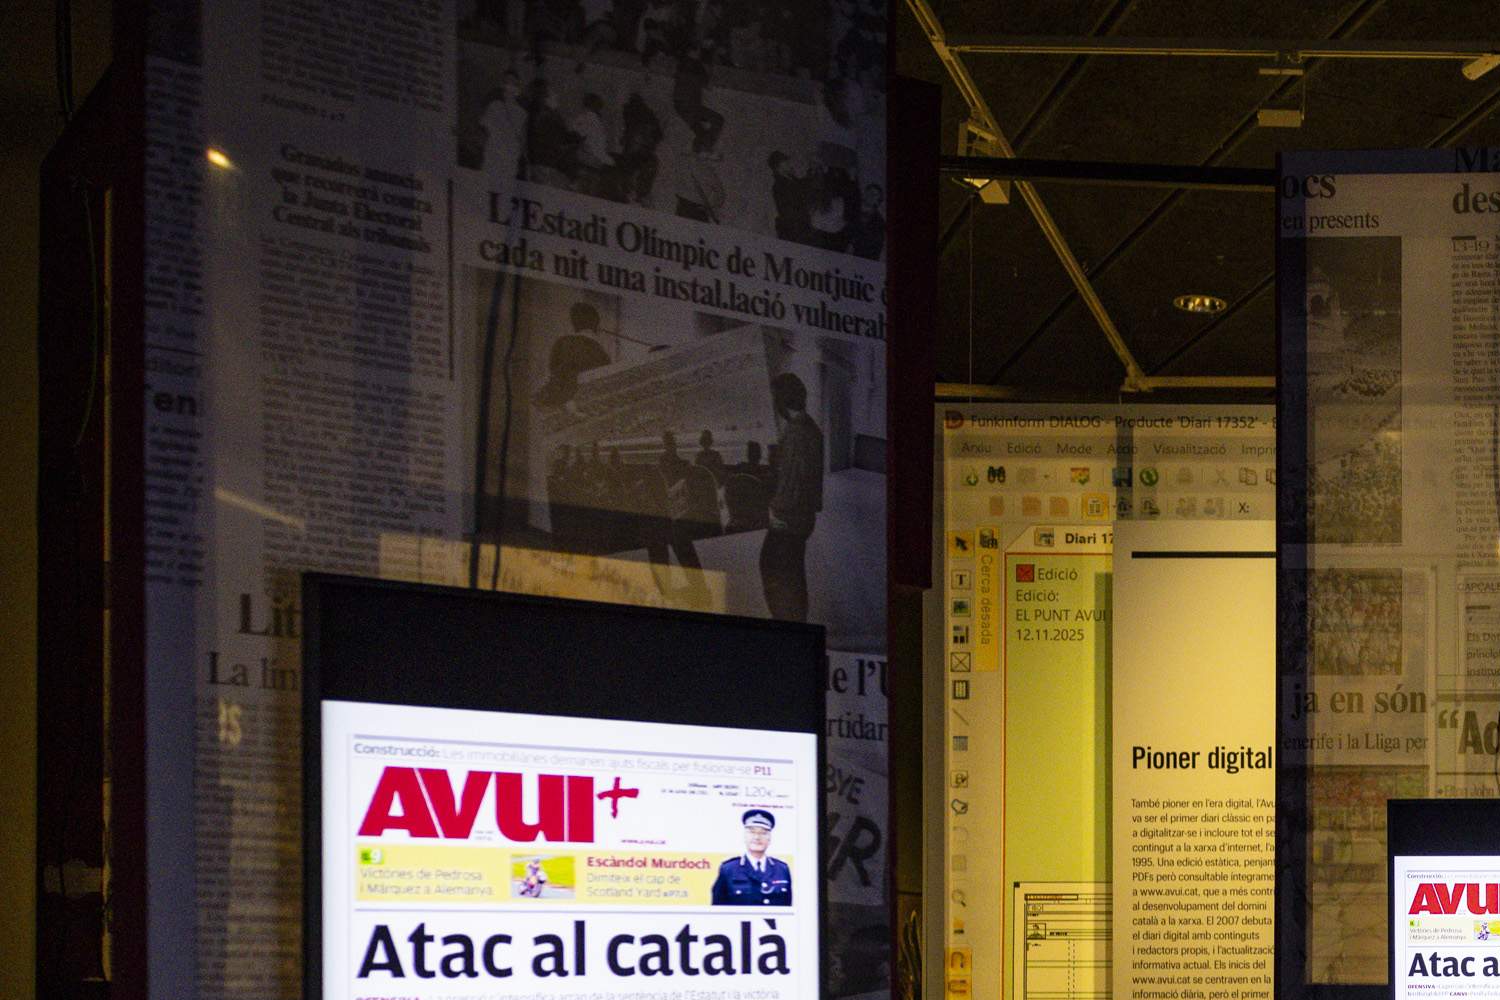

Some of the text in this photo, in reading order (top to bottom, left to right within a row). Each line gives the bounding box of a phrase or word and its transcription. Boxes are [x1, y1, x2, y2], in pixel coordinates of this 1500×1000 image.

[1309, 213, 1380, 231] presents
[488, 191, 876, 302] L'Estadi Olímpic de Montjuïc
[479, 238, 785, 319] cada nit una instal.lació
[1056, 443, 1226, 456] Mode Visualització
[1037, 567, 1078, 581] Edició
[1015, 589, 1060, 603] Edició:
[1034, 609, 1071, 622] PUNT
[1016, 628, 1085, 642] 12.11.2025
[1330, 685, 1428, 714] en són
[1364, 733, 1400, 755] Lliga
[353, 743, 772, 776] Construcció: P11
[1132, 746, 1272, 774] Pioner digital
[1132, 798, 1189, 810] També pioner
[1140, 829, 1238, 839] digitalitzar-se incloure
[586, 856, 710, 870] Escàndol Murdoch
[1132, 857, 1203, 867] 1995. edició
[1132, 872, 1228, 882] PDFs consultable
[1140, 887, 1200, 897] www.avui.cat,
[1142, 901, 1267, 913] desenvolupament domini
[356, 918, 791, 979] Atac al català
[1132, 960, 1180, 970] informativa
[1408, 952, 1475, 977] Atac
